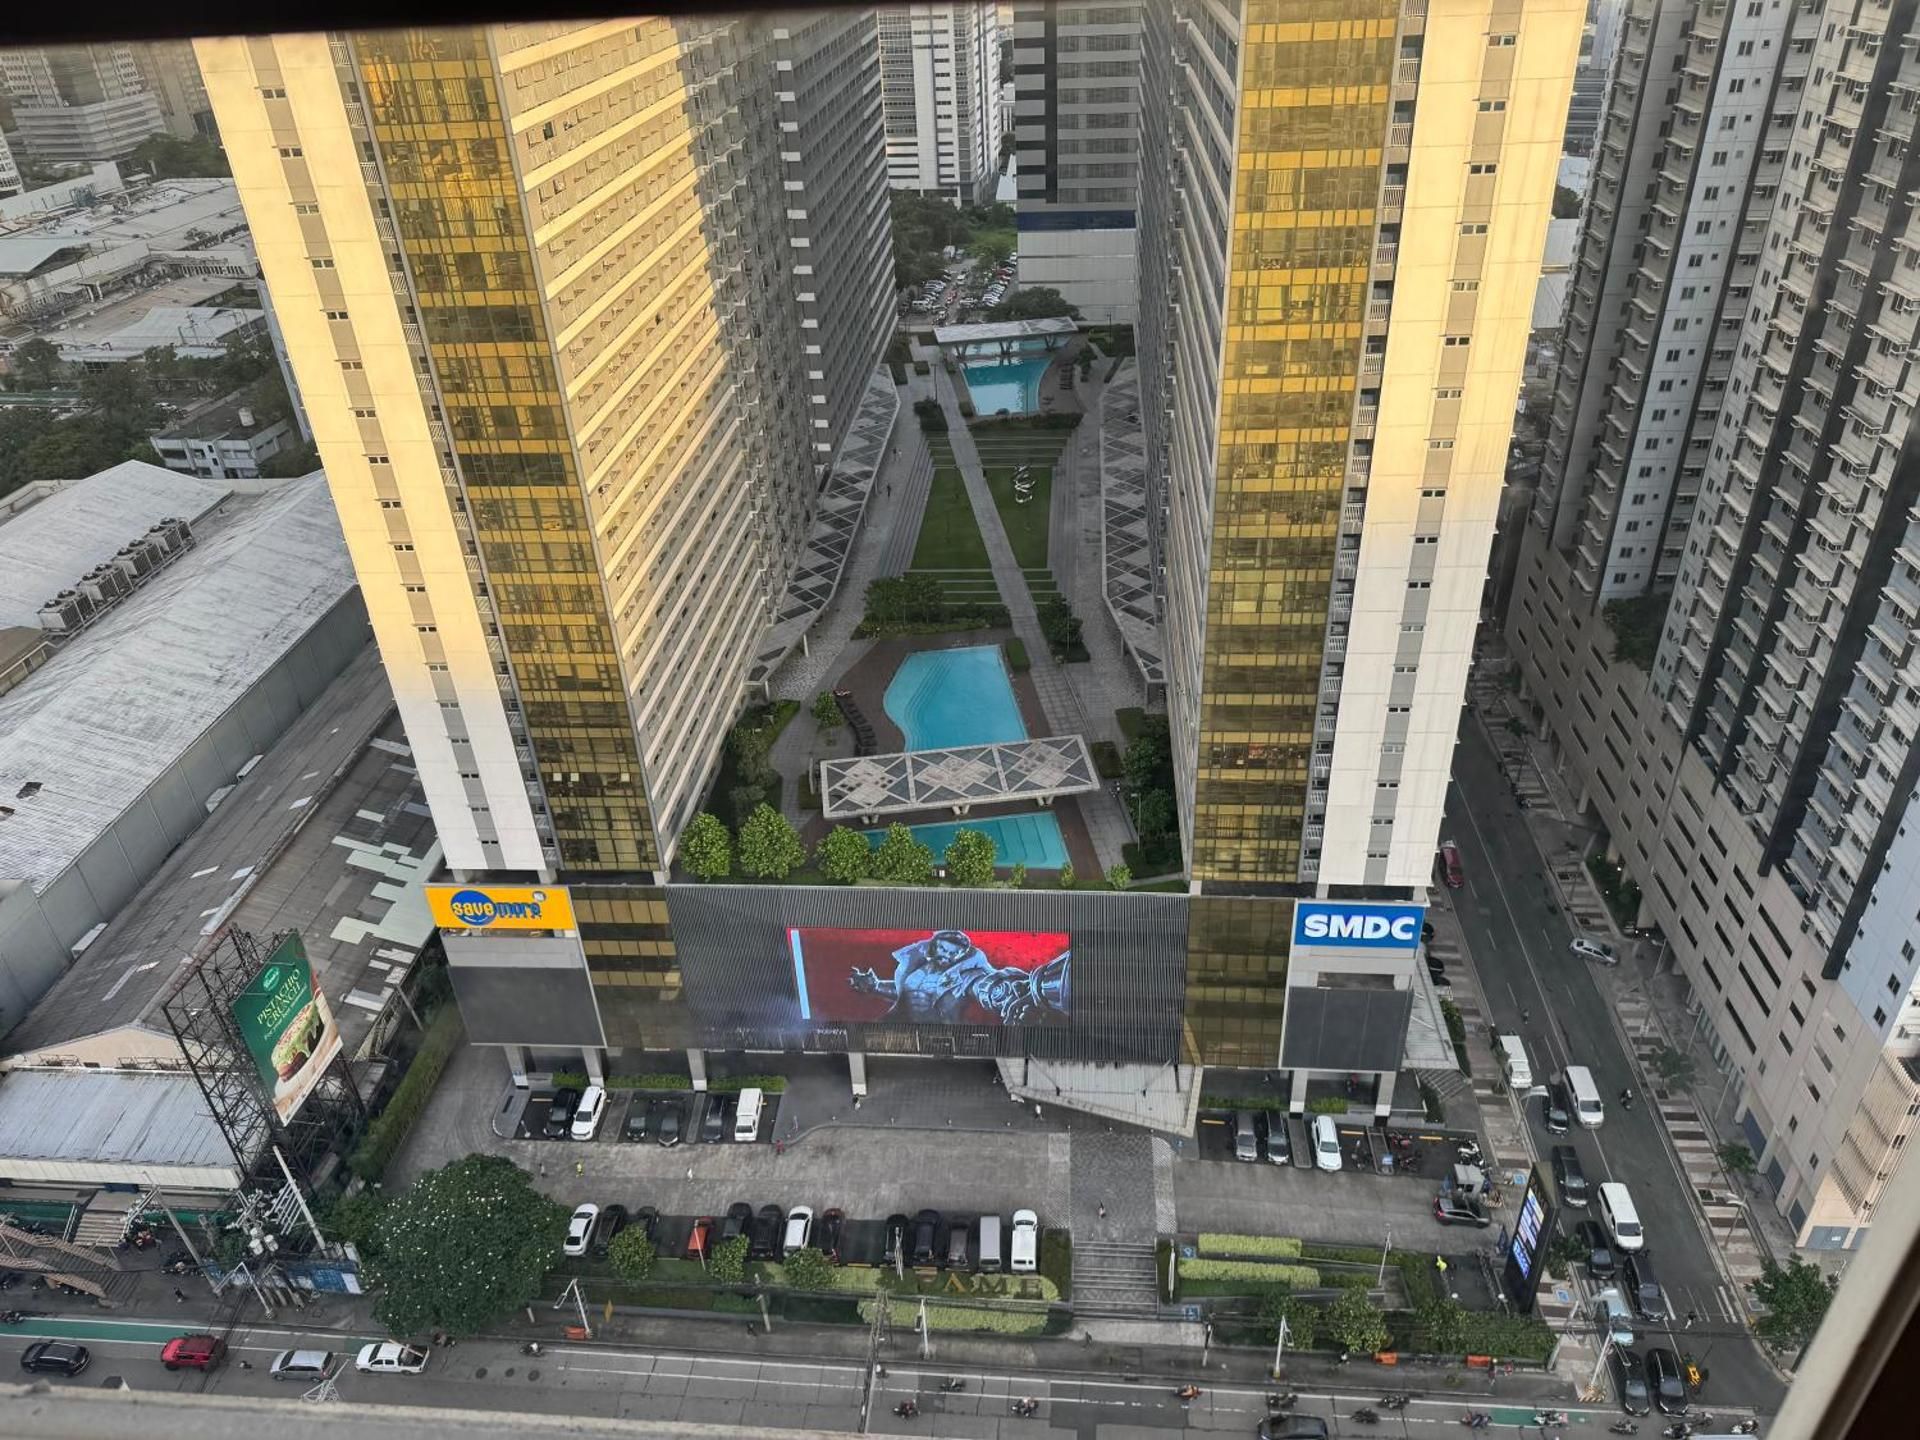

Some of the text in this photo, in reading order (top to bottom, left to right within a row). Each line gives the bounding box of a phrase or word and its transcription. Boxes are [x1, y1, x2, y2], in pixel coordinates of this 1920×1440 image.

[1304, 914, 1415, 940] SMDC
[256, 968, 301, 1025] PISTACHIO
[266, 981, 302, 1028] CRUNCH
